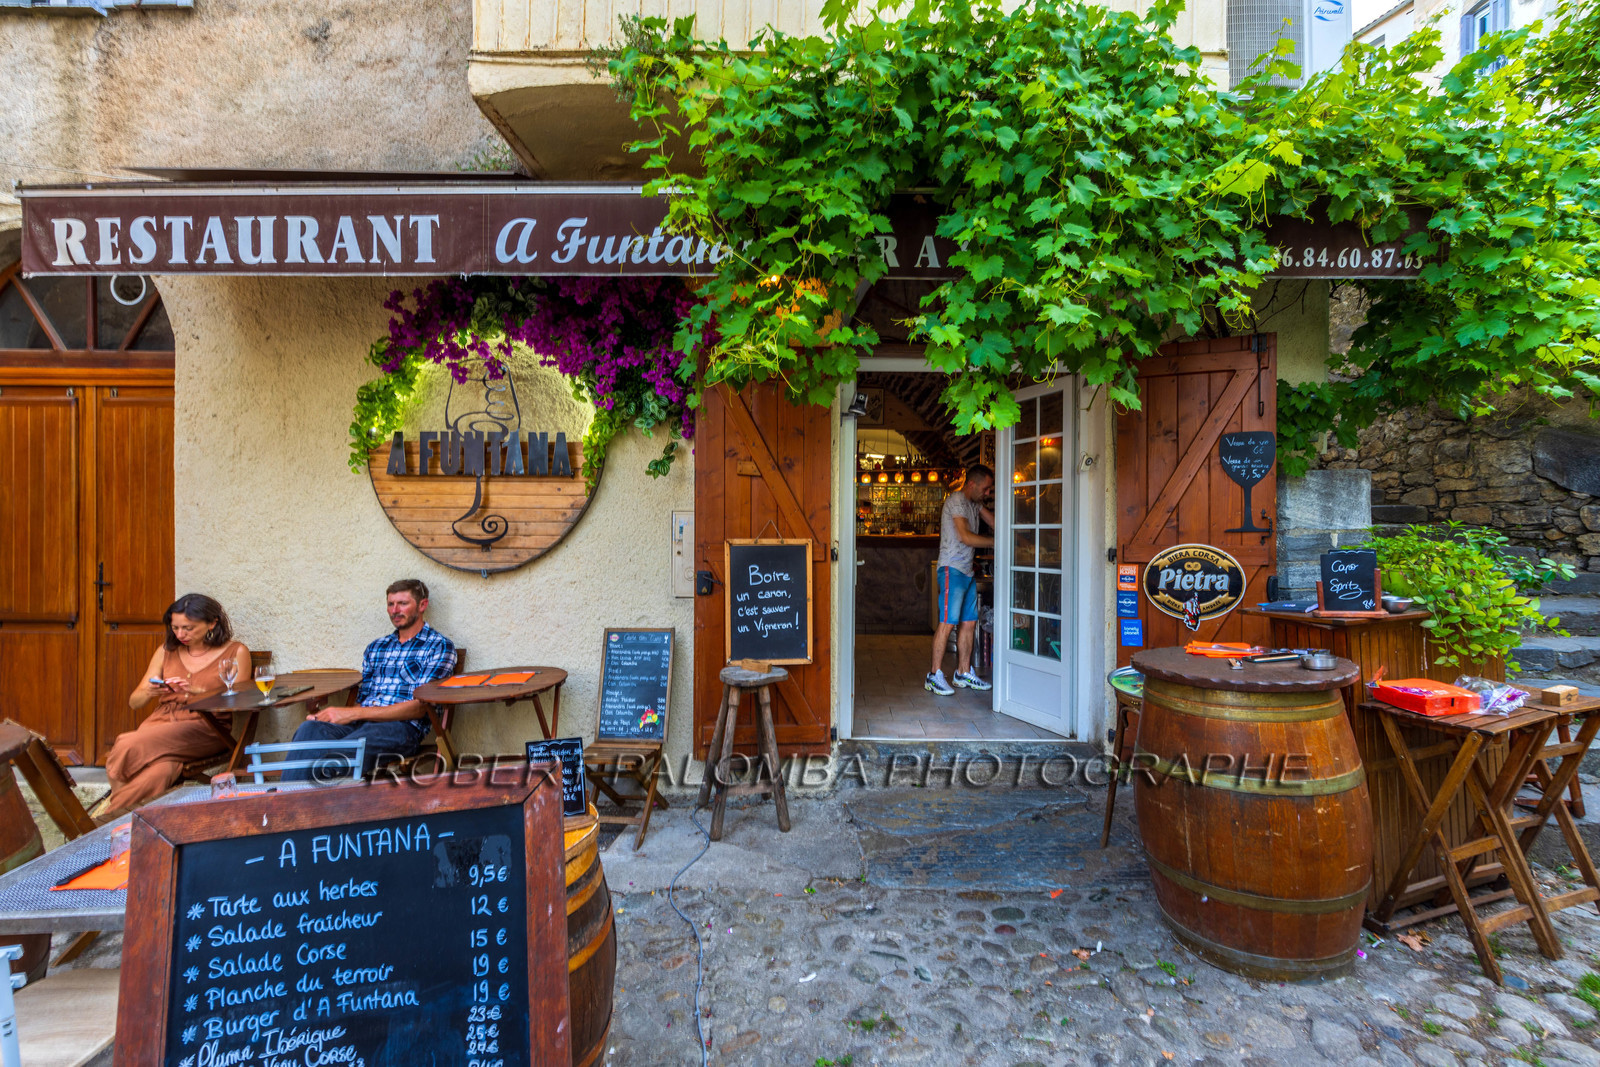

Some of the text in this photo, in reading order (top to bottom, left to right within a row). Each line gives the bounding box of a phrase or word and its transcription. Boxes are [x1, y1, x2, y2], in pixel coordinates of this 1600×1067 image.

[1313, 6, 1344, 14] Airwell
[50, 215, 440, 266] RESTAURANT
[494, 216, 753, 265] A Funtan
[1281, 246, 1424, 270] 6.84.60.87.63
[386, 430, 571, 476] A FUNTANA
[1167, 550, 1220, 564] BIERA CORSA
[748, 563, 791, 586] Boire
[1158, 568, 1230, 592] Pietra
[736, 589, 792, 602] un canon,
[737, 624, 750, 633] un
[278, 838, 297, 868] A
[312, 822, 431, 863] FUNTANA
[208, 894, 262, 917] Tarte
[272, 888, 311, 909] aux
[319, 877, 379, 901] herbes
[207, 918, 288, 947] Salade
[207, 950, 284, 979] Salade
[296, 942, 348, 966] Corse
[204, 973, 288, 1010] Planche
[296, 973, 324, 992] du
[331, 963, 395, 986] terroir
[202, 1009, 281, 1043] Burger
[336, 988, 420, 1013] Funtana
